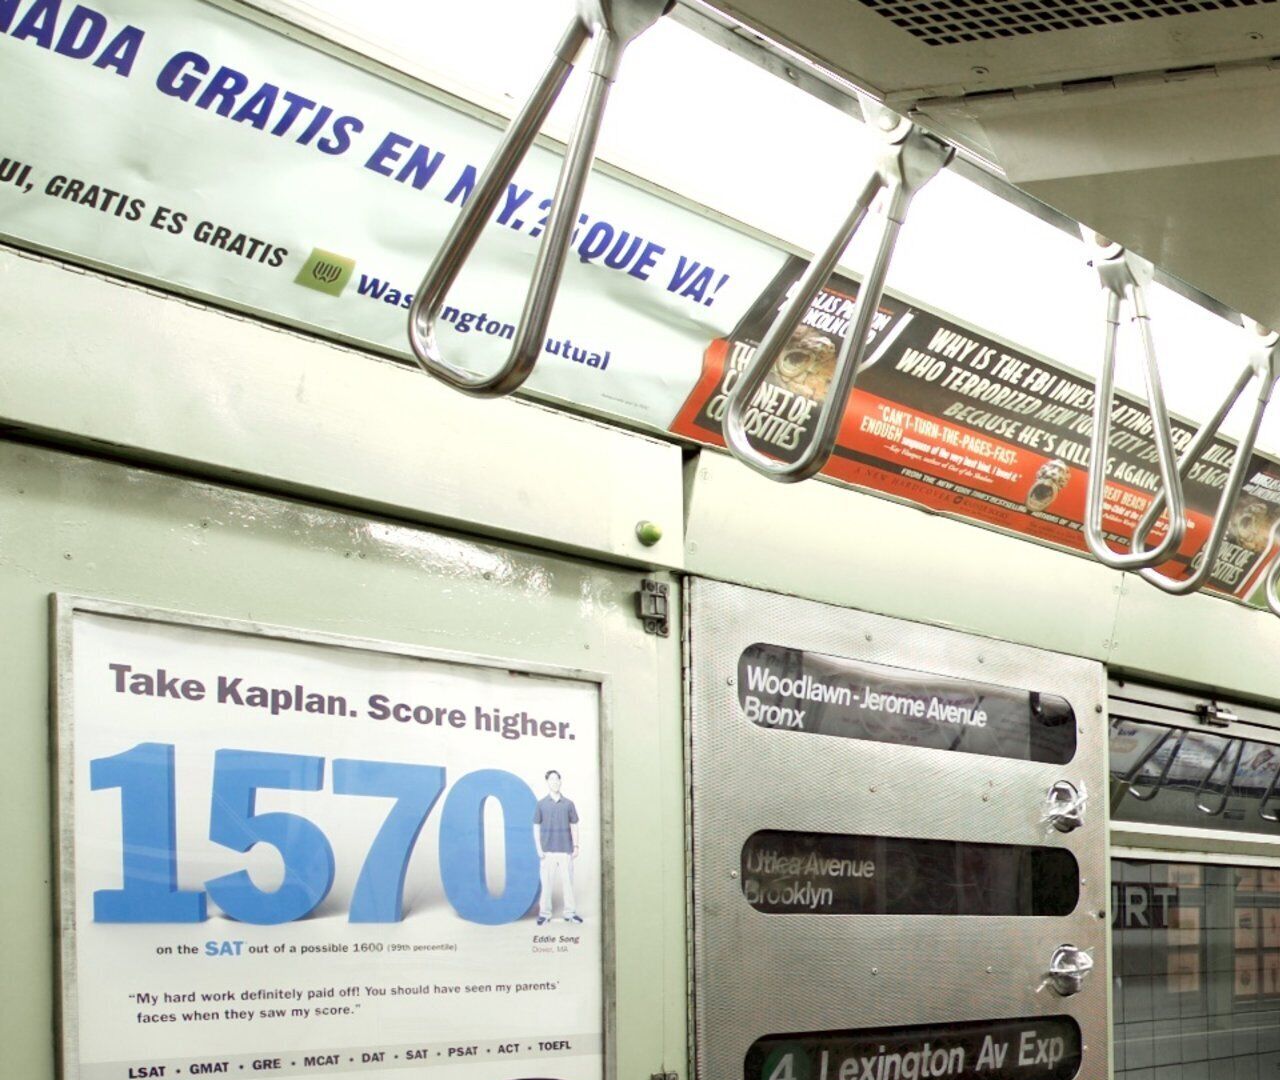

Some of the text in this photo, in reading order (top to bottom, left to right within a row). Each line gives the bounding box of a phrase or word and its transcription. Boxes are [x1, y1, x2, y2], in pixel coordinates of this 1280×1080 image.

[155, 51, 365, 156] GRATIS
[364, 131, 446, 191] EN
[666, 255, 731, 307] VA!
[0, 157, 289, 268] UI, GRATIS ES GRATIS
[356, 274, 611, 371] Wasngton utual
[927, 328, 980, 363] WHY
[969, 346, 997, 370] IS
[990, 353, 1031, 385] THE
[1022, 368, 1058, 396] FBI
[787, 391, 819, 427] OF
[895, 347, 948, 383] WHO
[940, 365, 1043, 415] TERRORIZED
[1035, 403, 1078, 428] NEW
[1112, 427, 1149, 453] CITY
[860, 415, 904, 443] ENOUGH
[943, 401, 1161, 492] BECAUSE HE'S KILLG AGAIN.
[108, 662, 577, 742] Take Kaplan. Score higher.
[743, 695, 805, 729] Bronx
[926, 696, 988, 728] Avenue
[89, 741, 543, 927] 1570
[803, 851, 876, 878] Avenue
[744, 879, 833, 910] Brooklyn
[156, 944, 173, 955] on
[177, 944, 199, 955] the
[204, 940, 244, 957] SAT
[248, 943, 269, 954] out
[273, 942, 285, 954] of
[289, 945, 297, 954] a
[300, 943, 349, 956] possible
[353, 942, 384, 954] 1600
[533, 935, 580, 945] Eddie Song
[164, 991, 196, 1004] hard
[201, 990, 236, 1003] work
[240, 988, 303, 1003] definitely
[307, 987, 336, 1000] paid
[338, 986, 360, 998] off!
[365, 986, 387, 996] You
[390, 984, 431, 996] should
[433, 984, 461, 994] have
[465, 984, 492, 994] seen
[496, 984, 512, 995] my
[136, 1011, 178, 1024] faces
[182, 1009, 220, 1022] when
[224, 1008, 255, 1022] they
[259, 1007, 287, 1018] saw
[290, 1007, 311, 1019] my
[128, 1040, 572, 1080] LSAT GMAT GRE MCAT DAT SAT PSAT ACT TOEFL
[975, 1034, 1009, 1071] Av
[1018, 1030, 1065, 1071] Exp
